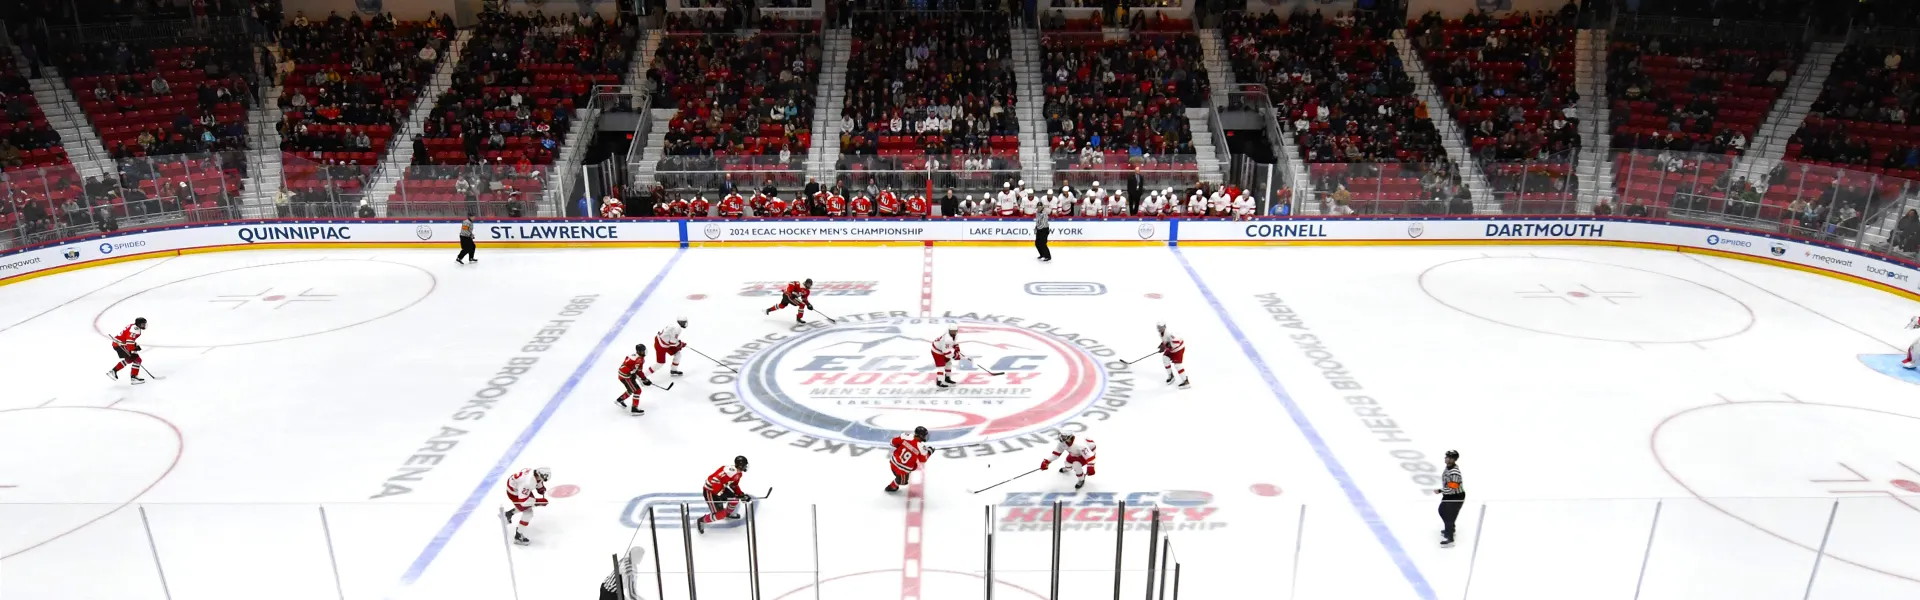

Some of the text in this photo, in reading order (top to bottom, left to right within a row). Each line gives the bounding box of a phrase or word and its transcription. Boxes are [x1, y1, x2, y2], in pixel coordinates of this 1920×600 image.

[238, 226, 351, 243] QUINNIPIAC
[491, 225, 618, 239] ST. LAWRENCE
[729, 228, 924, 236] 2024 ECAC HOCKEY MEN'S CHAMPIONSHIP
[969, 227, 1032, 237] LAKE PLACID,
[1058, 227, 1083, 236] YORK
[1245, 224, 1327, 237] CORNELL
[1485, 223, 1604, 237] DARTMOUTH
[0, 256, 41, 270] megawatt
[1812, 253, 1853, 267] megawatt
[1866, 265, 1909, 282] touchpoint
[1252, 292, 1311, 330] ARENA
[708, 332, 789, 385] OLYMPIC
[943, 310, 1025, 326] LAKE
[1028, 322, 1116, 358] PLACID
[1082, 360, 1135, 422] OLYMPIC
[1289, 333, 1364, 390] BROOKS
[368, 293, 601, 500] 1980 HERB BROOKS ARENA
[708, 391, 791, 440] PLACID
[1343, 394, 1413, 442] HERB
[899, 447, 913, 464] 19
[1000, 507, 1220, 522] HOCKEY
